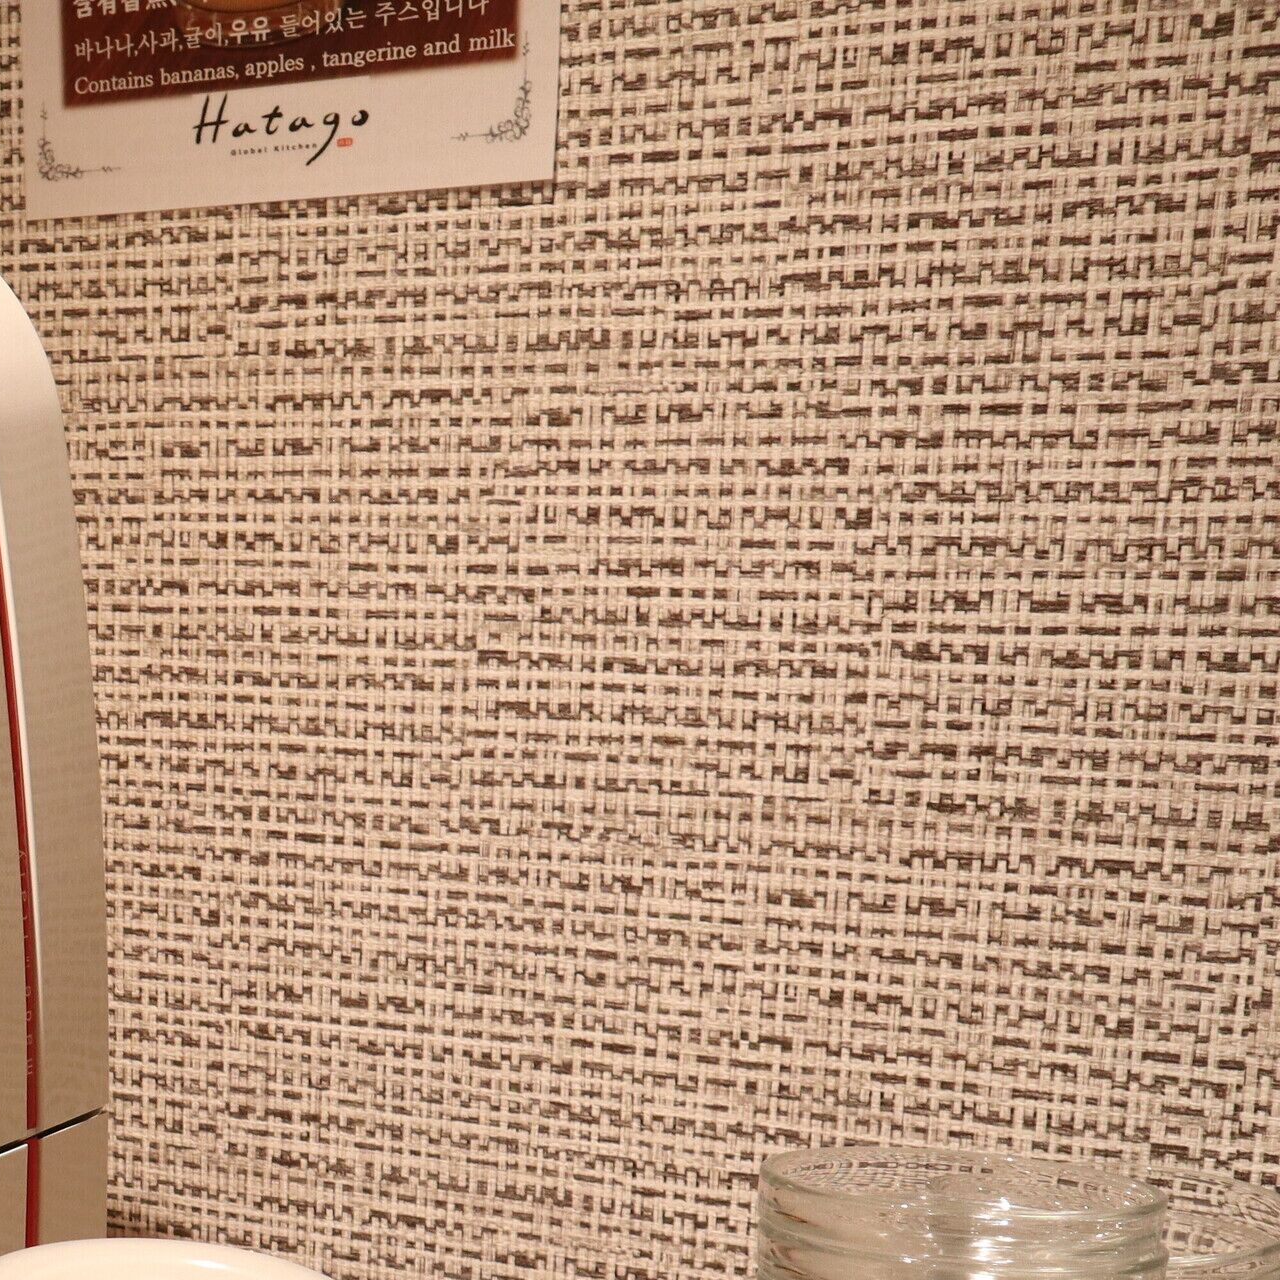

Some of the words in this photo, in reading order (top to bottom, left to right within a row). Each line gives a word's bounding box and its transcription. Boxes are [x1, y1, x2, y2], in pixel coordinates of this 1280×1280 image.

[74, 70, 154, 95] Contains
[160, 64, 240, 86] bananas,
[322, 42, 417, 68] tangerine
[423, 34, 461, 56] and
[469, 28, 516, 51] milk
[192, 92, 370, 166] Hatago
